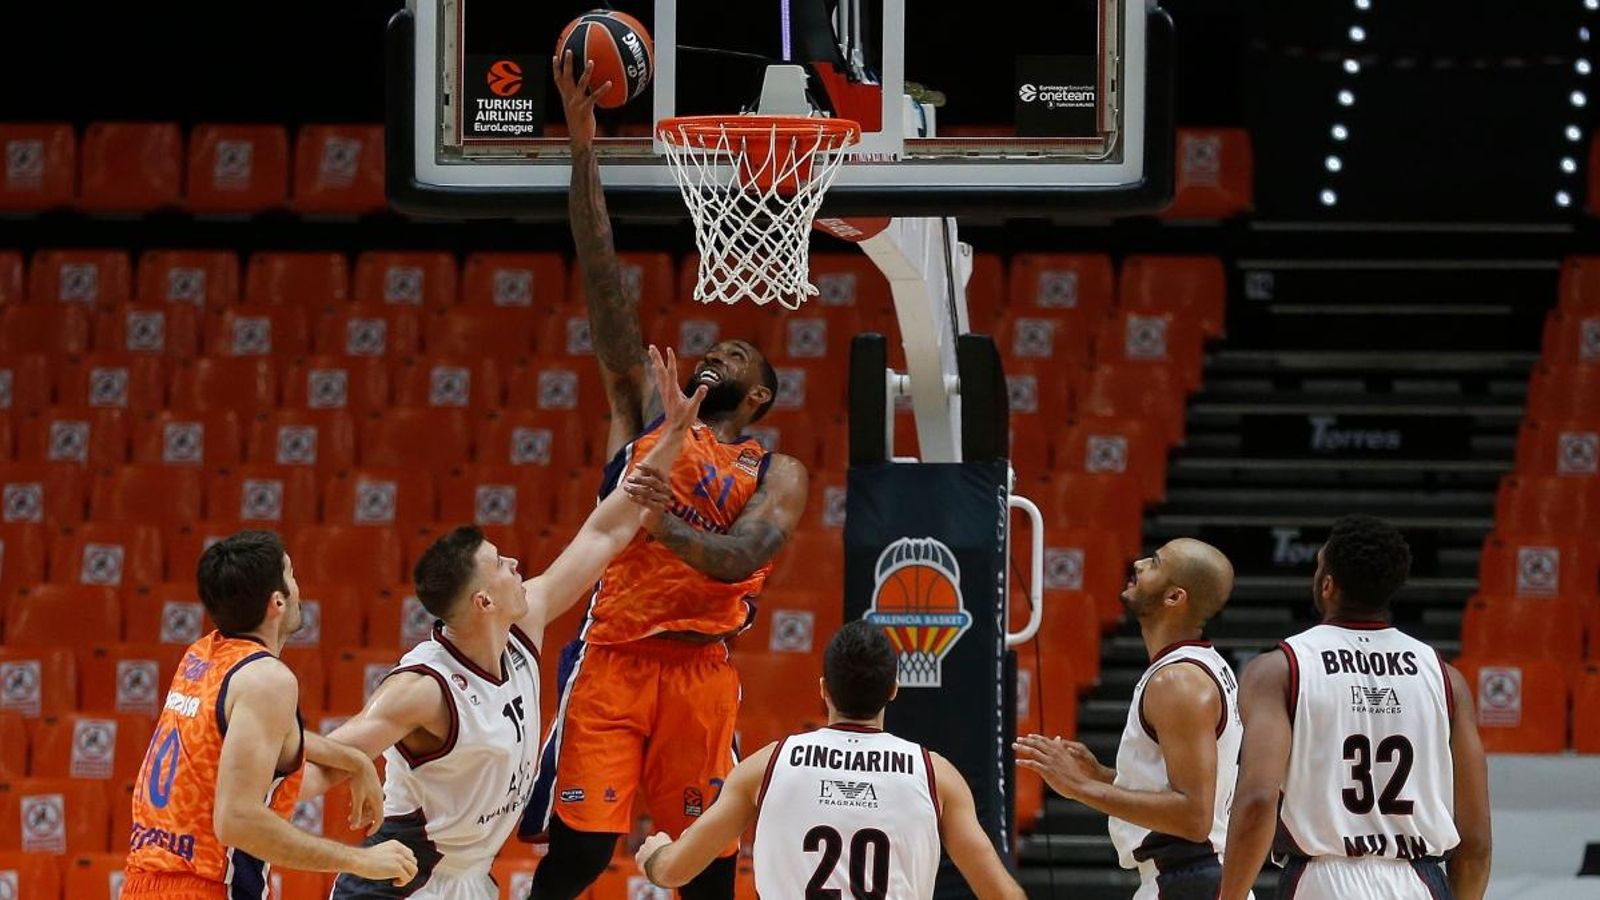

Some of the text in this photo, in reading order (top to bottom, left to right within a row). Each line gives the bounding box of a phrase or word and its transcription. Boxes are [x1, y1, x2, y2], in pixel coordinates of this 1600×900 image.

[476, 99, 533, 110] TURKISH
[1039, 90, 1095, 101] oneteam
[475, 110, 533, 122] AIRLINES
[474, 122, 534, 135] EuroLeague
[1309, 415, 1402, 449] Torres
[693, 464, 735, 510] 21
[1271, 528, 1313, 562] Tor
[925, 613, 964, 626] BASKET
[1321, 649, 1418, 677] BROOKS
[1352, 706, 1402, 715] FRARANCES
[789, 745, 915, 775] CINCIARINI
[1342, 733, 1415, 815] 32
[818, 799, 879, 809] FRAGRANCES
[803, 825, 891, 900] 20
